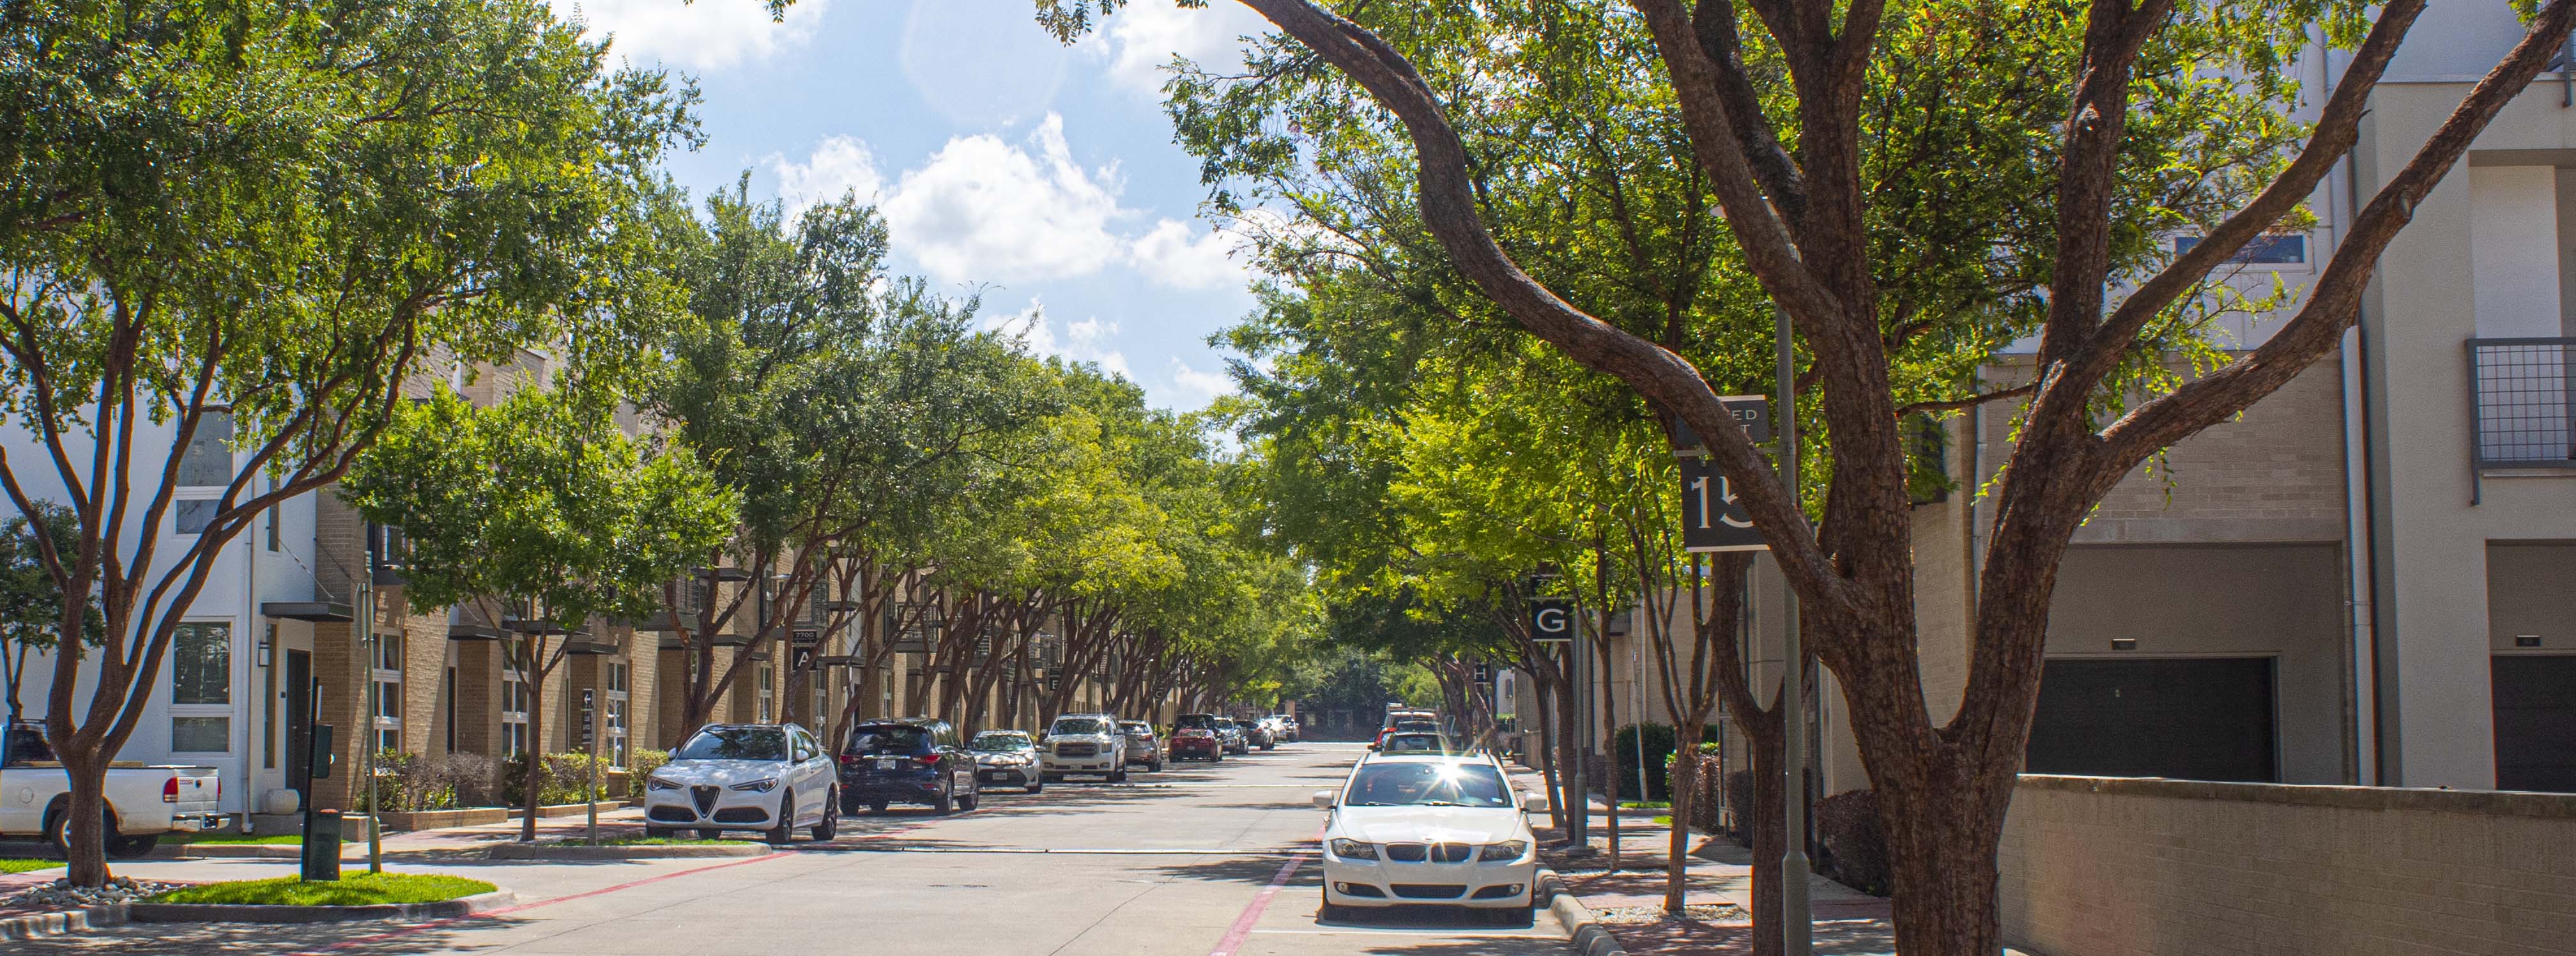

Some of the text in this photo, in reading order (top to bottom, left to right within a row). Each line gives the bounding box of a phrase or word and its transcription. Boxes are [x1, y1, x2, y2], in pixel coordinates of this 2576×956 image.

[1537, 608, 1565, 632] G
[797, 651, 809, 667] A
[1474, 668, 1485, 679] H
